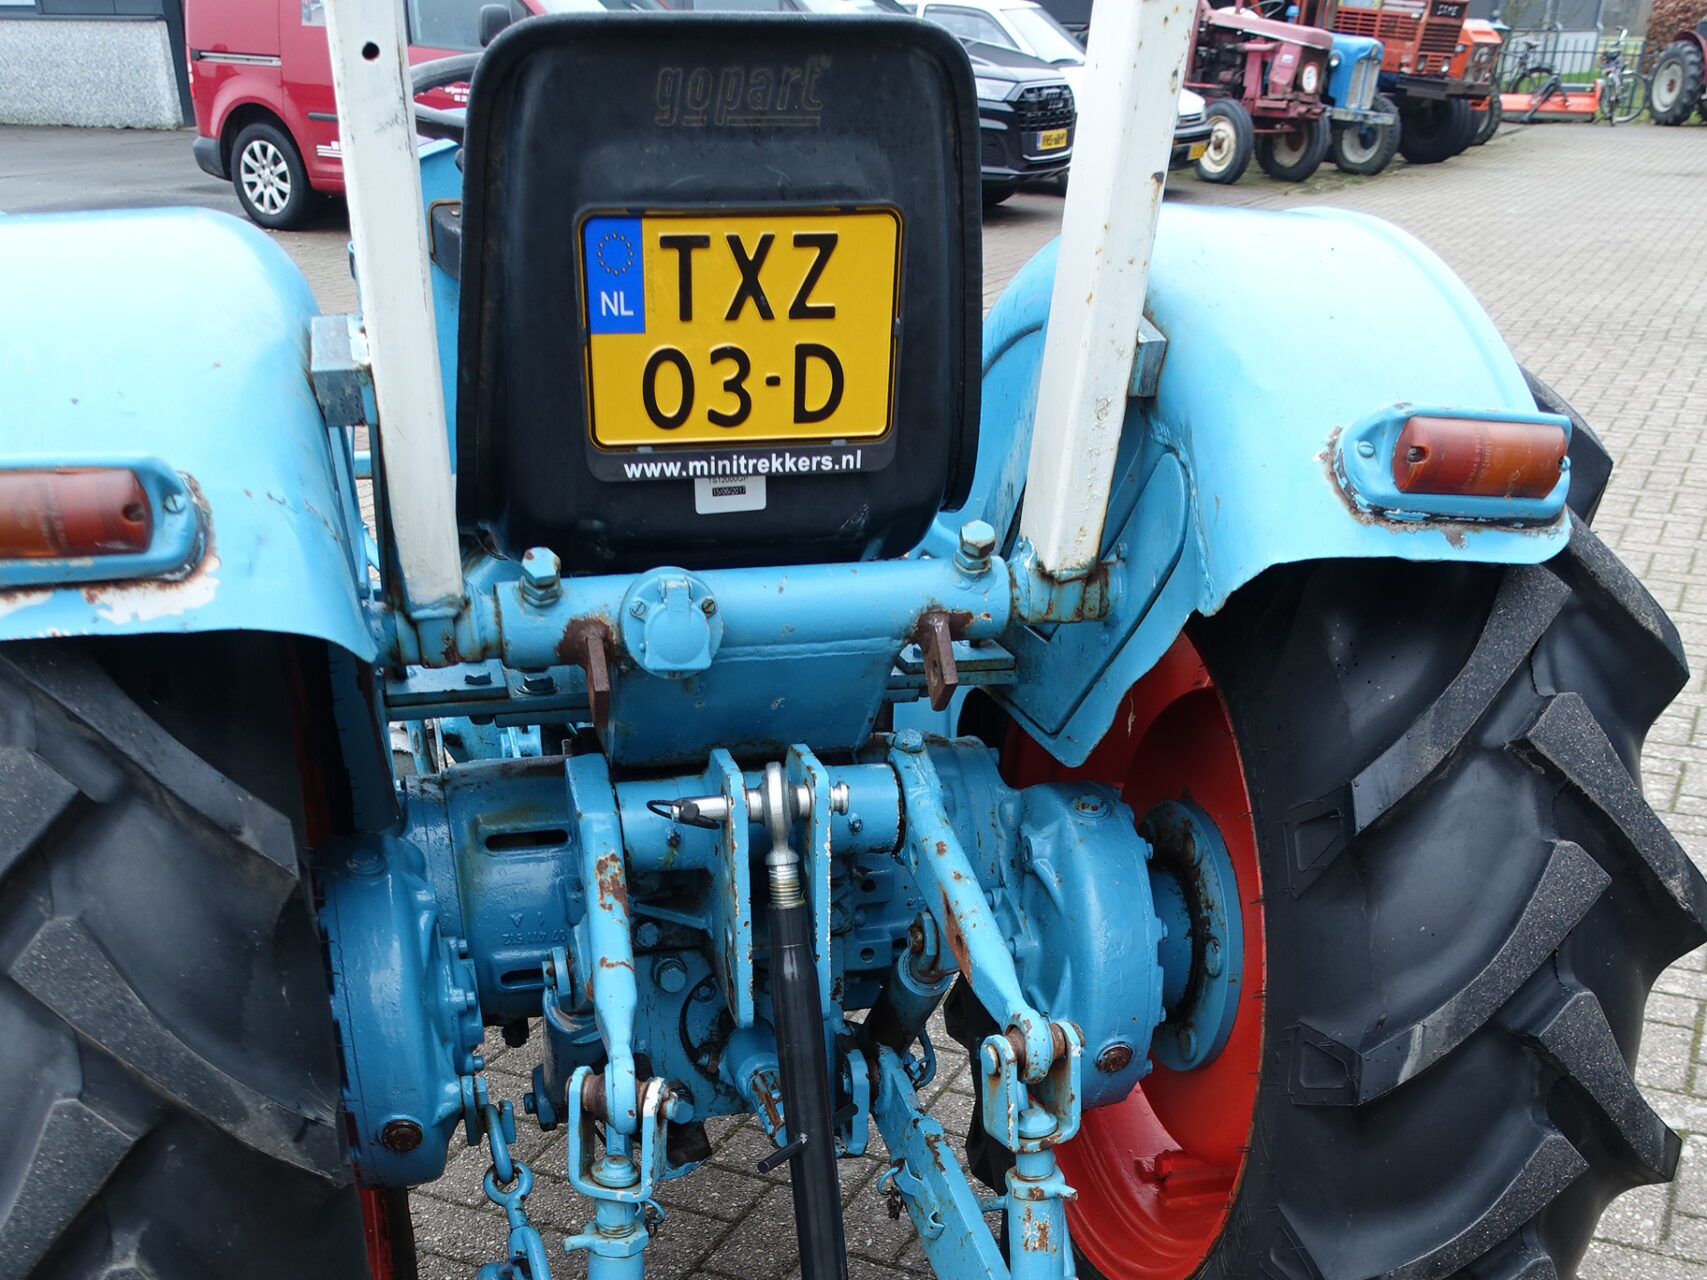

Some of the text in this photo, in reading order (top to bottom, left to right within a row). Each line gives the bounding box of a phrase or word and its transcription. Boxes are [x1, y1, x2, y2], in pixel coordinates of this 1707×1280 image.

[600, 291, 634, 317] NL
[659, 233, 839, 322] TXZ
[642, 343, 845, 430] 03-D
[623, 449, 862, 479] www.minitrekkers.nl
